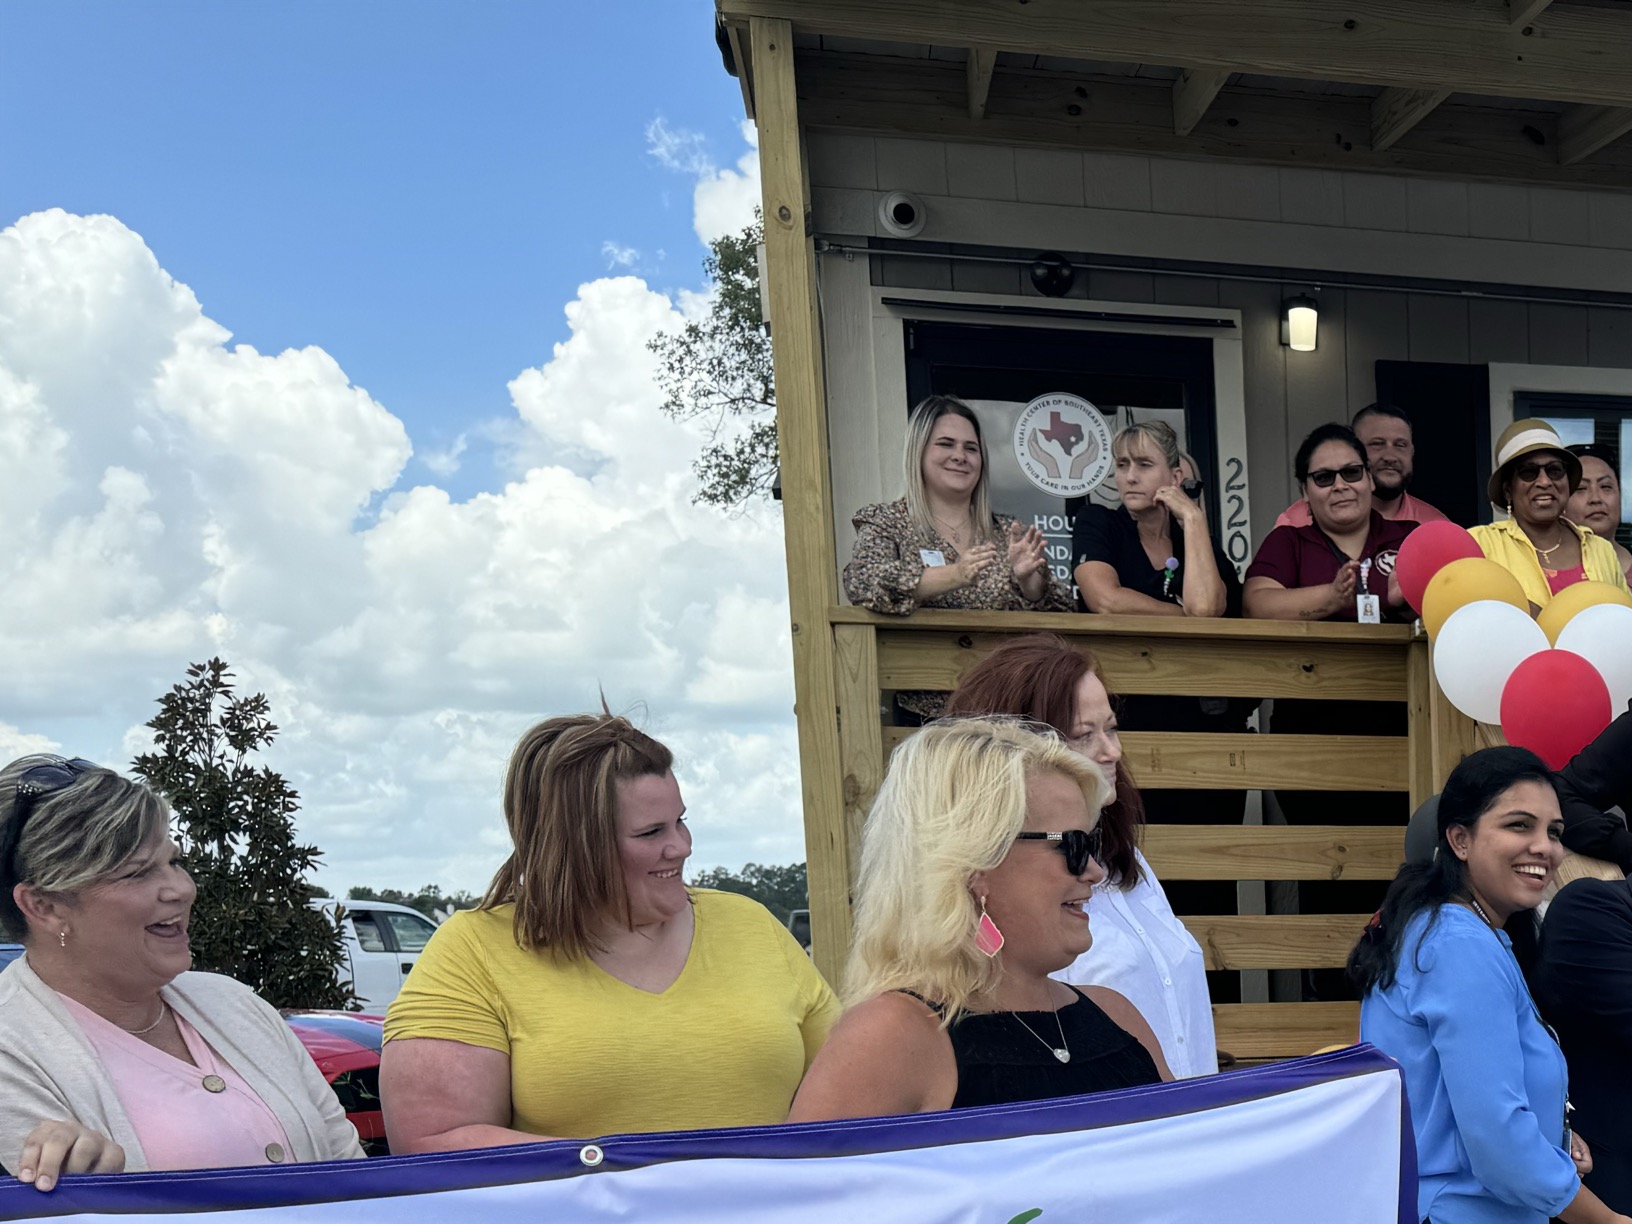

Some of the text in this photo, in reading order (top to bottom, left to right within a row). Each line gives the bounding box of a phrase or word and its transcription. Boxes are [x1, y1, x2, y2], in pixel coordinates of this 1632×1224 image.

[1018, 418, 1029, 446] HEALTH
[1027, 400, 1051, 418] CENTER
[1064, 400, 1101, 428] SOUTHEAST
[1099, 428, 1108, 452] TEXAS
[1025, 461, 1040, 480] YOUR
[1040, 478, 1059, 490] CARE
[1086, 465, 1105, 486] HANDS
[1225, 457, 1249, 575] 220
